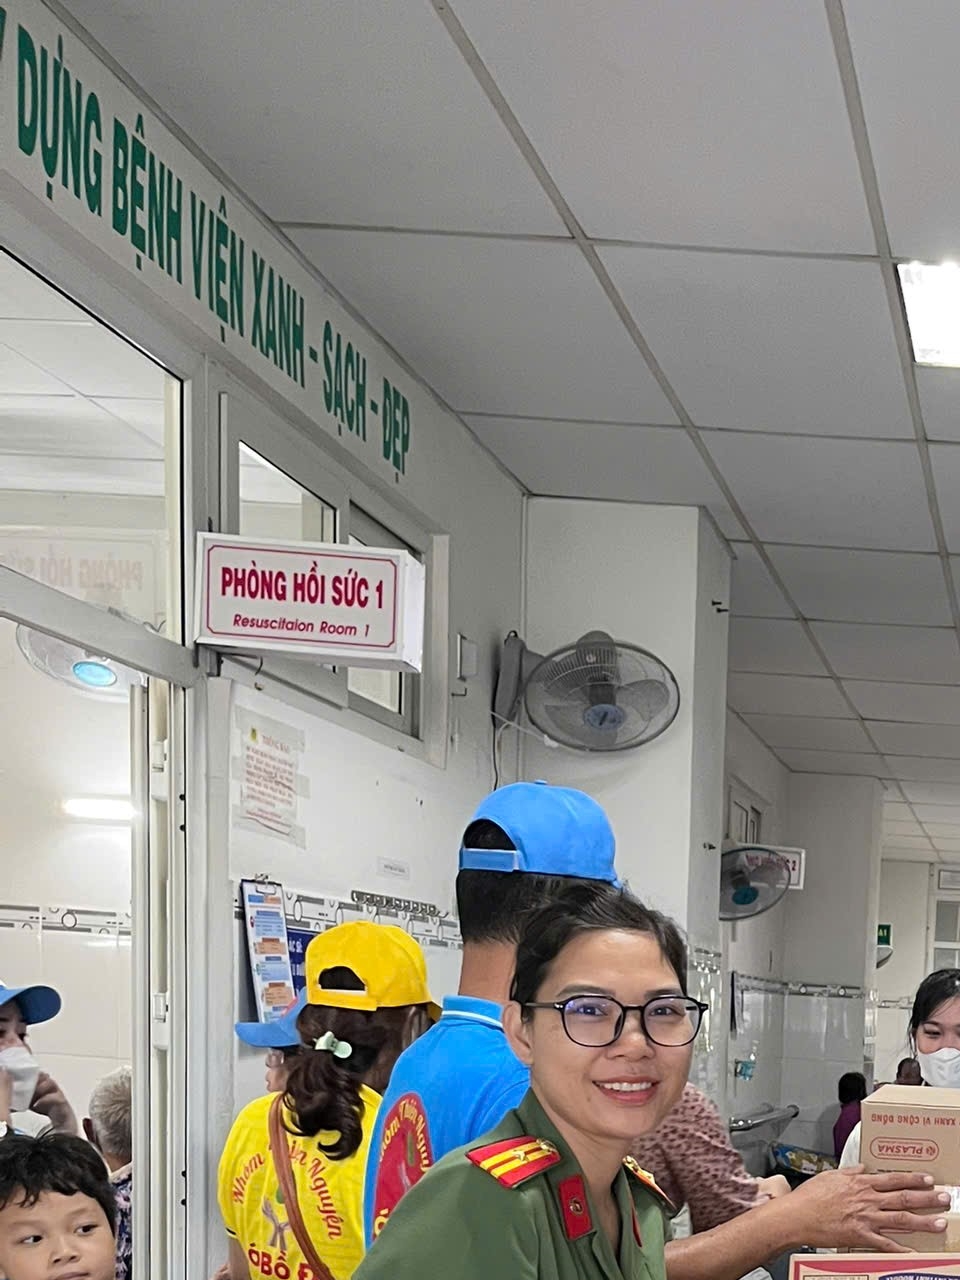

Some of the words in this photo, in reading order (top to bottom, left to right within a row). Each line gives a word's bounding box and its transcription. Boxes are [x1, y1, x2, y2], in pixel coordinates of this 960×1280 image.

[18, 23, 102, 217] DỰNG
[112, 113, 182, 285] BỆNH
[190, 195, 244, 343] VIỆN
[251, 250, 305, 389] XANH
[322, 320, 367, 442] SẠCH
[382, 377, 410, 484] ĐẸP
[221, 561, 287, 601] PHÒNG
[294, 561, 326, 605] HỒI
[332, 568, 369, 608] SỨC
[376, 580, 384, 608] 1
[233, 613, 315, 633] Resuscitaion
[320, 621, 358, 636] Room
[364, 624, 370, 637] 1
[877, 1144, 923, 1155] PLASMA
